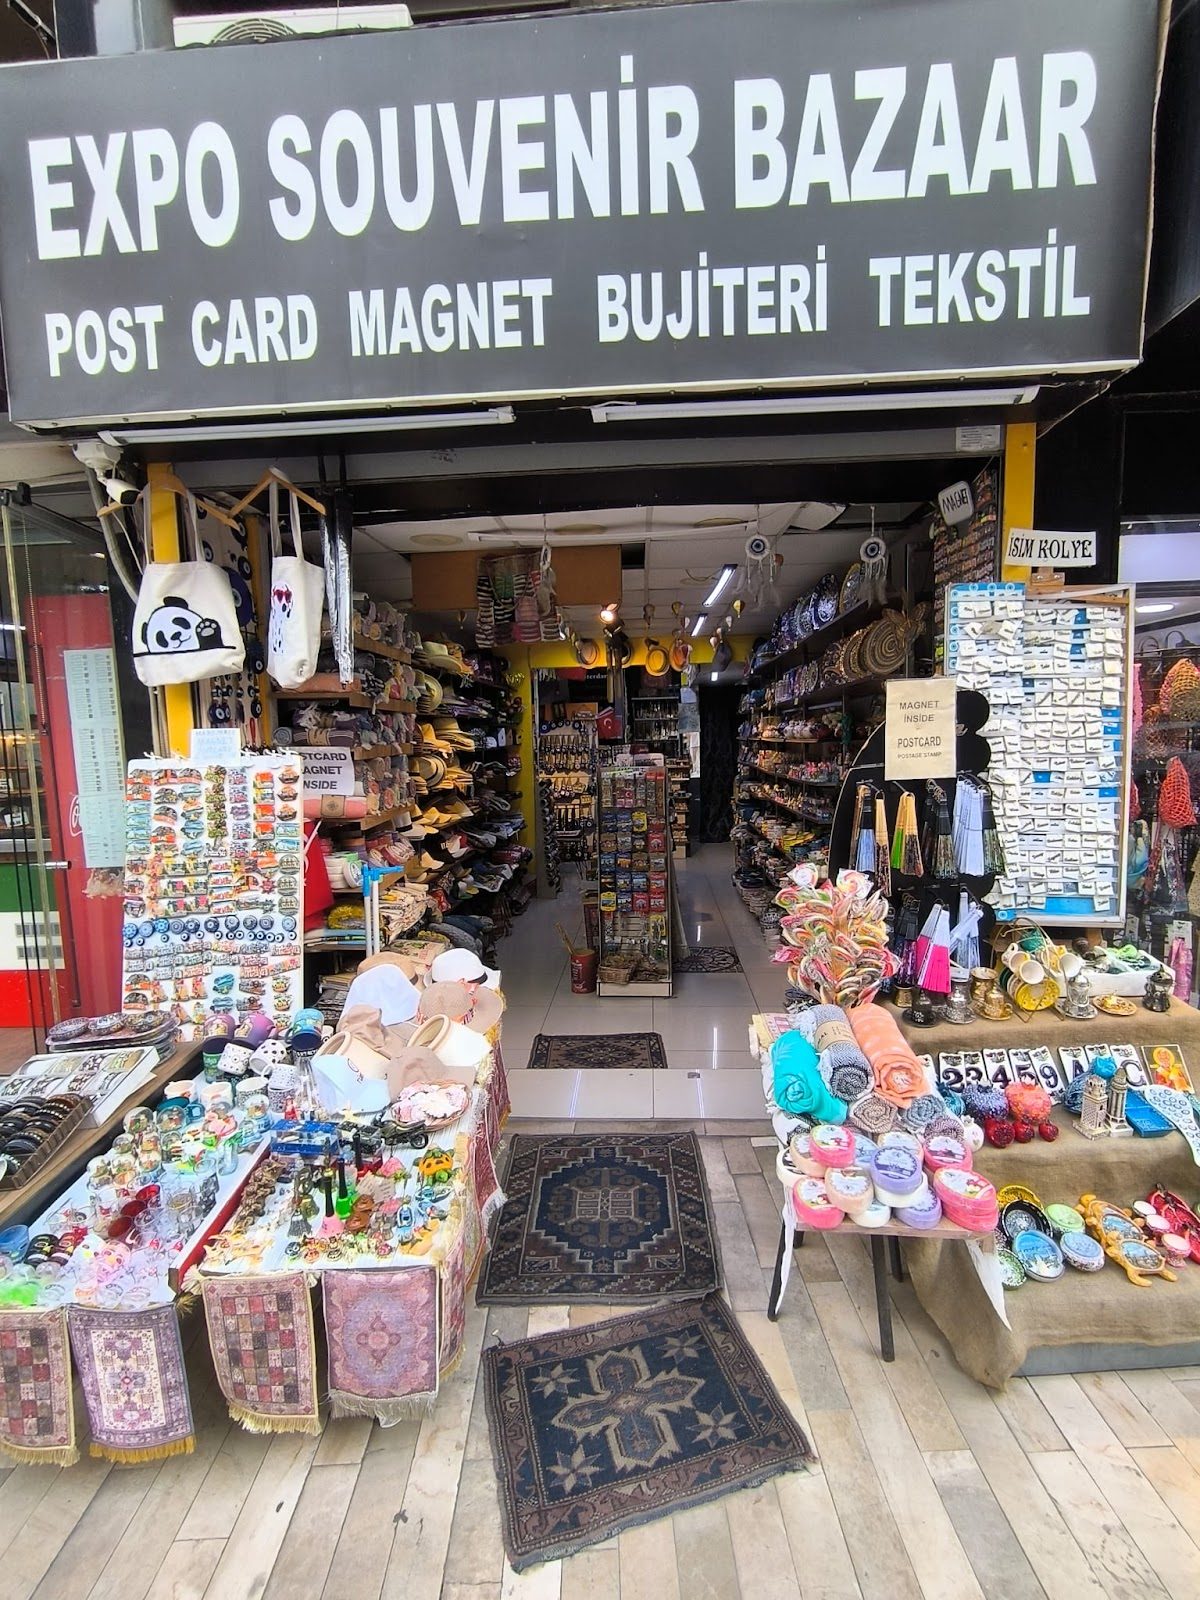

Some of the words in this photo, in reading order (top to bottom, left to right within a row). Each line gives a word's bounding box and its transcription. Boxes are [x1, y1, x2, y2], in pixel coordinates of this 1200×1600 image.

[28, 122, 240, 260] EXPO
[267, 55, 705, 241] SOUVENİR
[734, 50, 1098, 209] BAZAAR
[44, 304, 164, 377] POST
[191, 294, 318, 367] CARD
[348, 278, 553, 357] MAGNET
[597, 244, 829, 343] BUJİTERİ
[869, 228, 1091, 327] TEKSTİL
[1038, 538, 1093, 559] KOLYE
[899, 700, 940, 710] MAGNET
[897, 735, 942, 748] POSTCARD
[300, 752, 347, 761] STCARD
[897, 751, 922, 759] POSTAGE
[923, 750, 943, 758] STAMP
[302, 765, 342, 775] AGNET
[303, 780, 337, 790] NSIDE
[992, 1064, 1012, 1089] 4
[1039, 1062, 1059, 1089] 9
